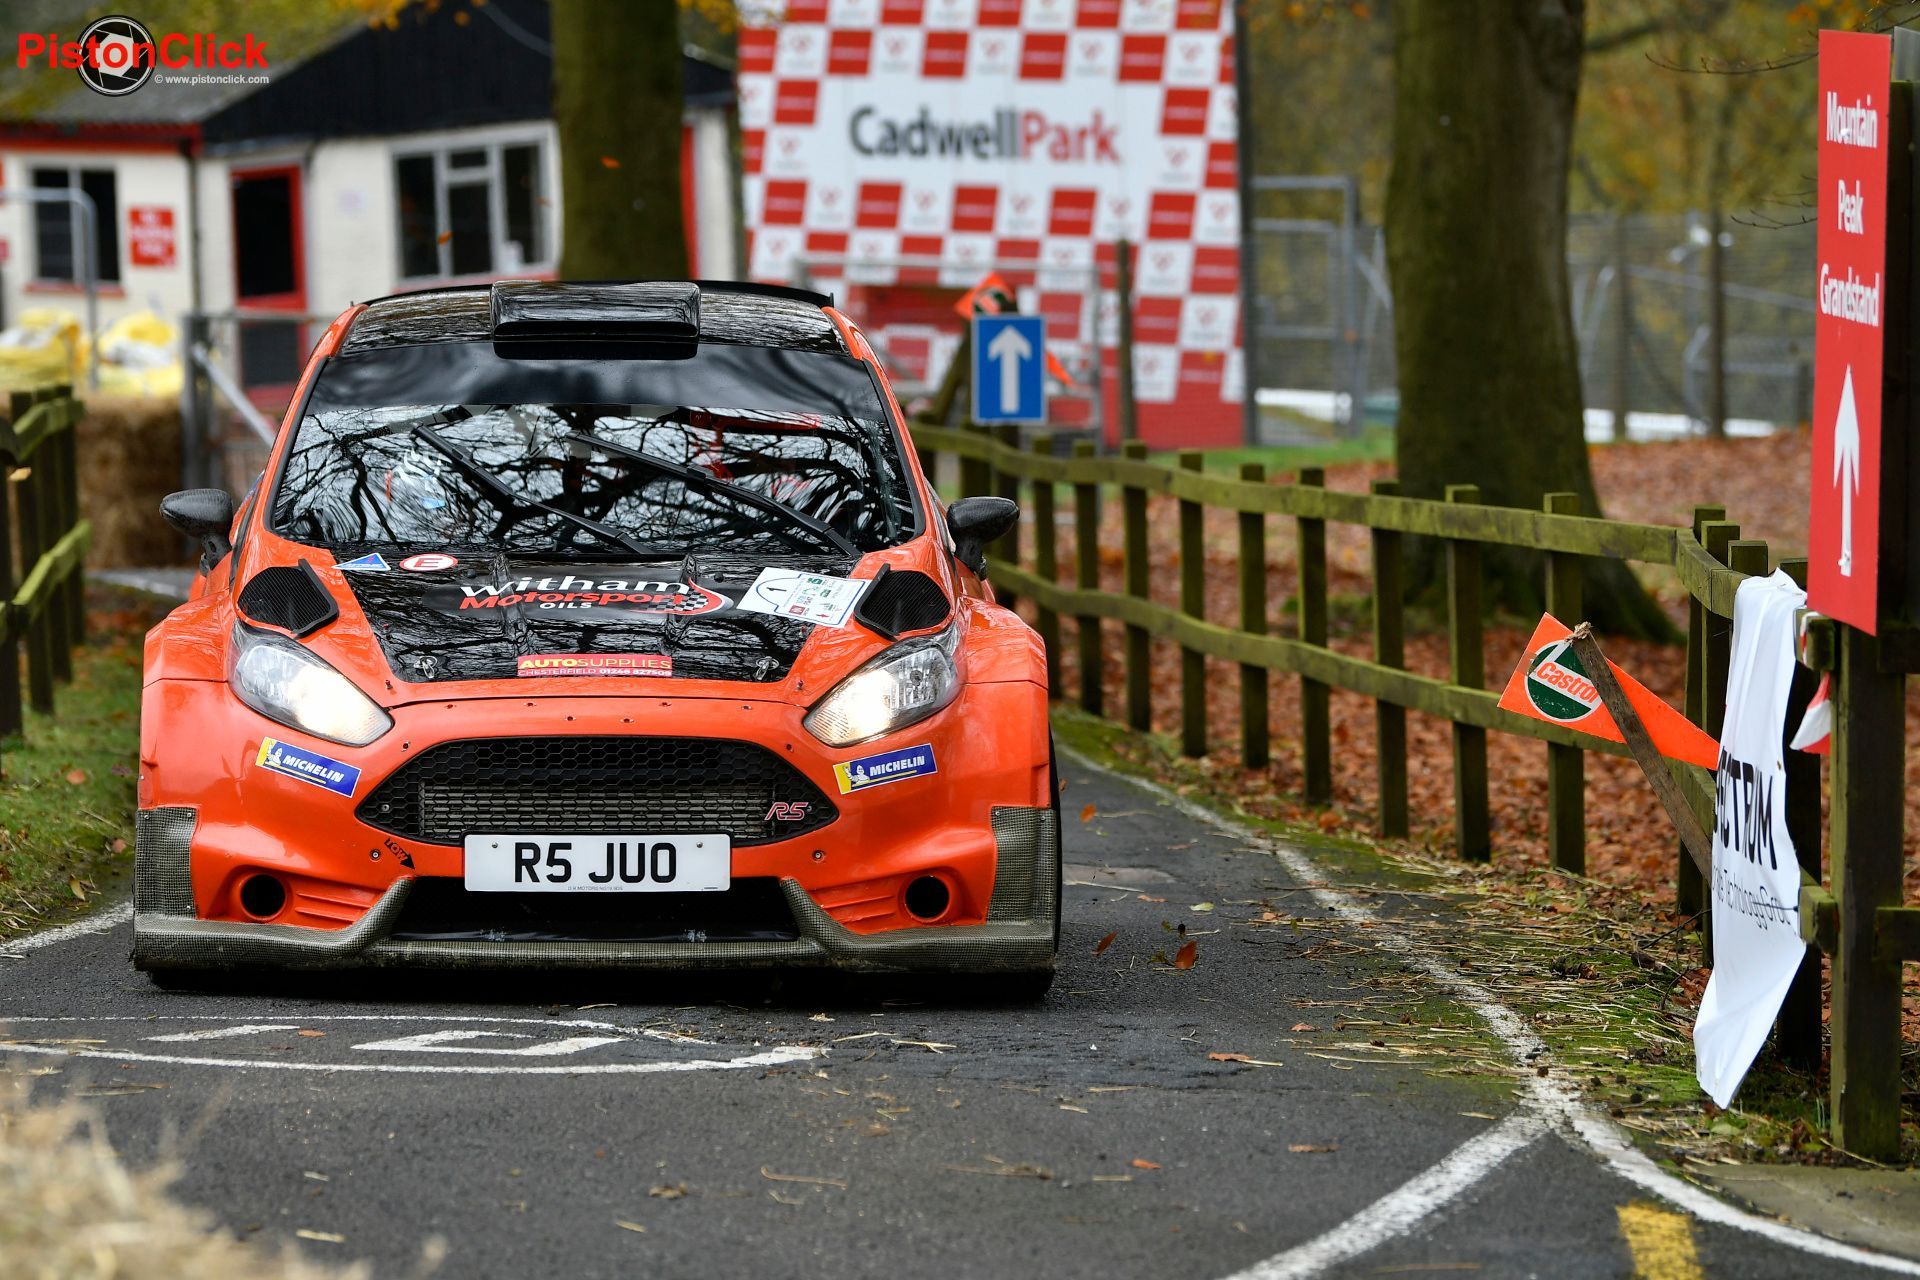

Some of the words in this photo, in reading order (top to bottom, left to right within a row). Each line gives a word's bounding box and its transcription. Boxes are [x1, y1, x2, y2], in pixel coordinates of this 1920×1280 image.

[1826, 91, 1878, 148] Mountain
[1837, 179, 1864, 235] Peak
[1820, 263, 1880, 328] Grandstand
[413, 558, 444, 569] E
[460, 576, 689, 596] Witham
[459, 592, 684, 610] Motorsport
[539, 602, 592, 610] OILS
[518, 658, 671, 669] AUTOSUPPLIES
[518, 669, 596, 677] CHESTERFIELD
[282, 755, 345, 783] MICHELIN
[869, 755, 925, 776] MICHELIN
[514, 842, 572, 883] R5
[588, 842, 677, 883] JUO
